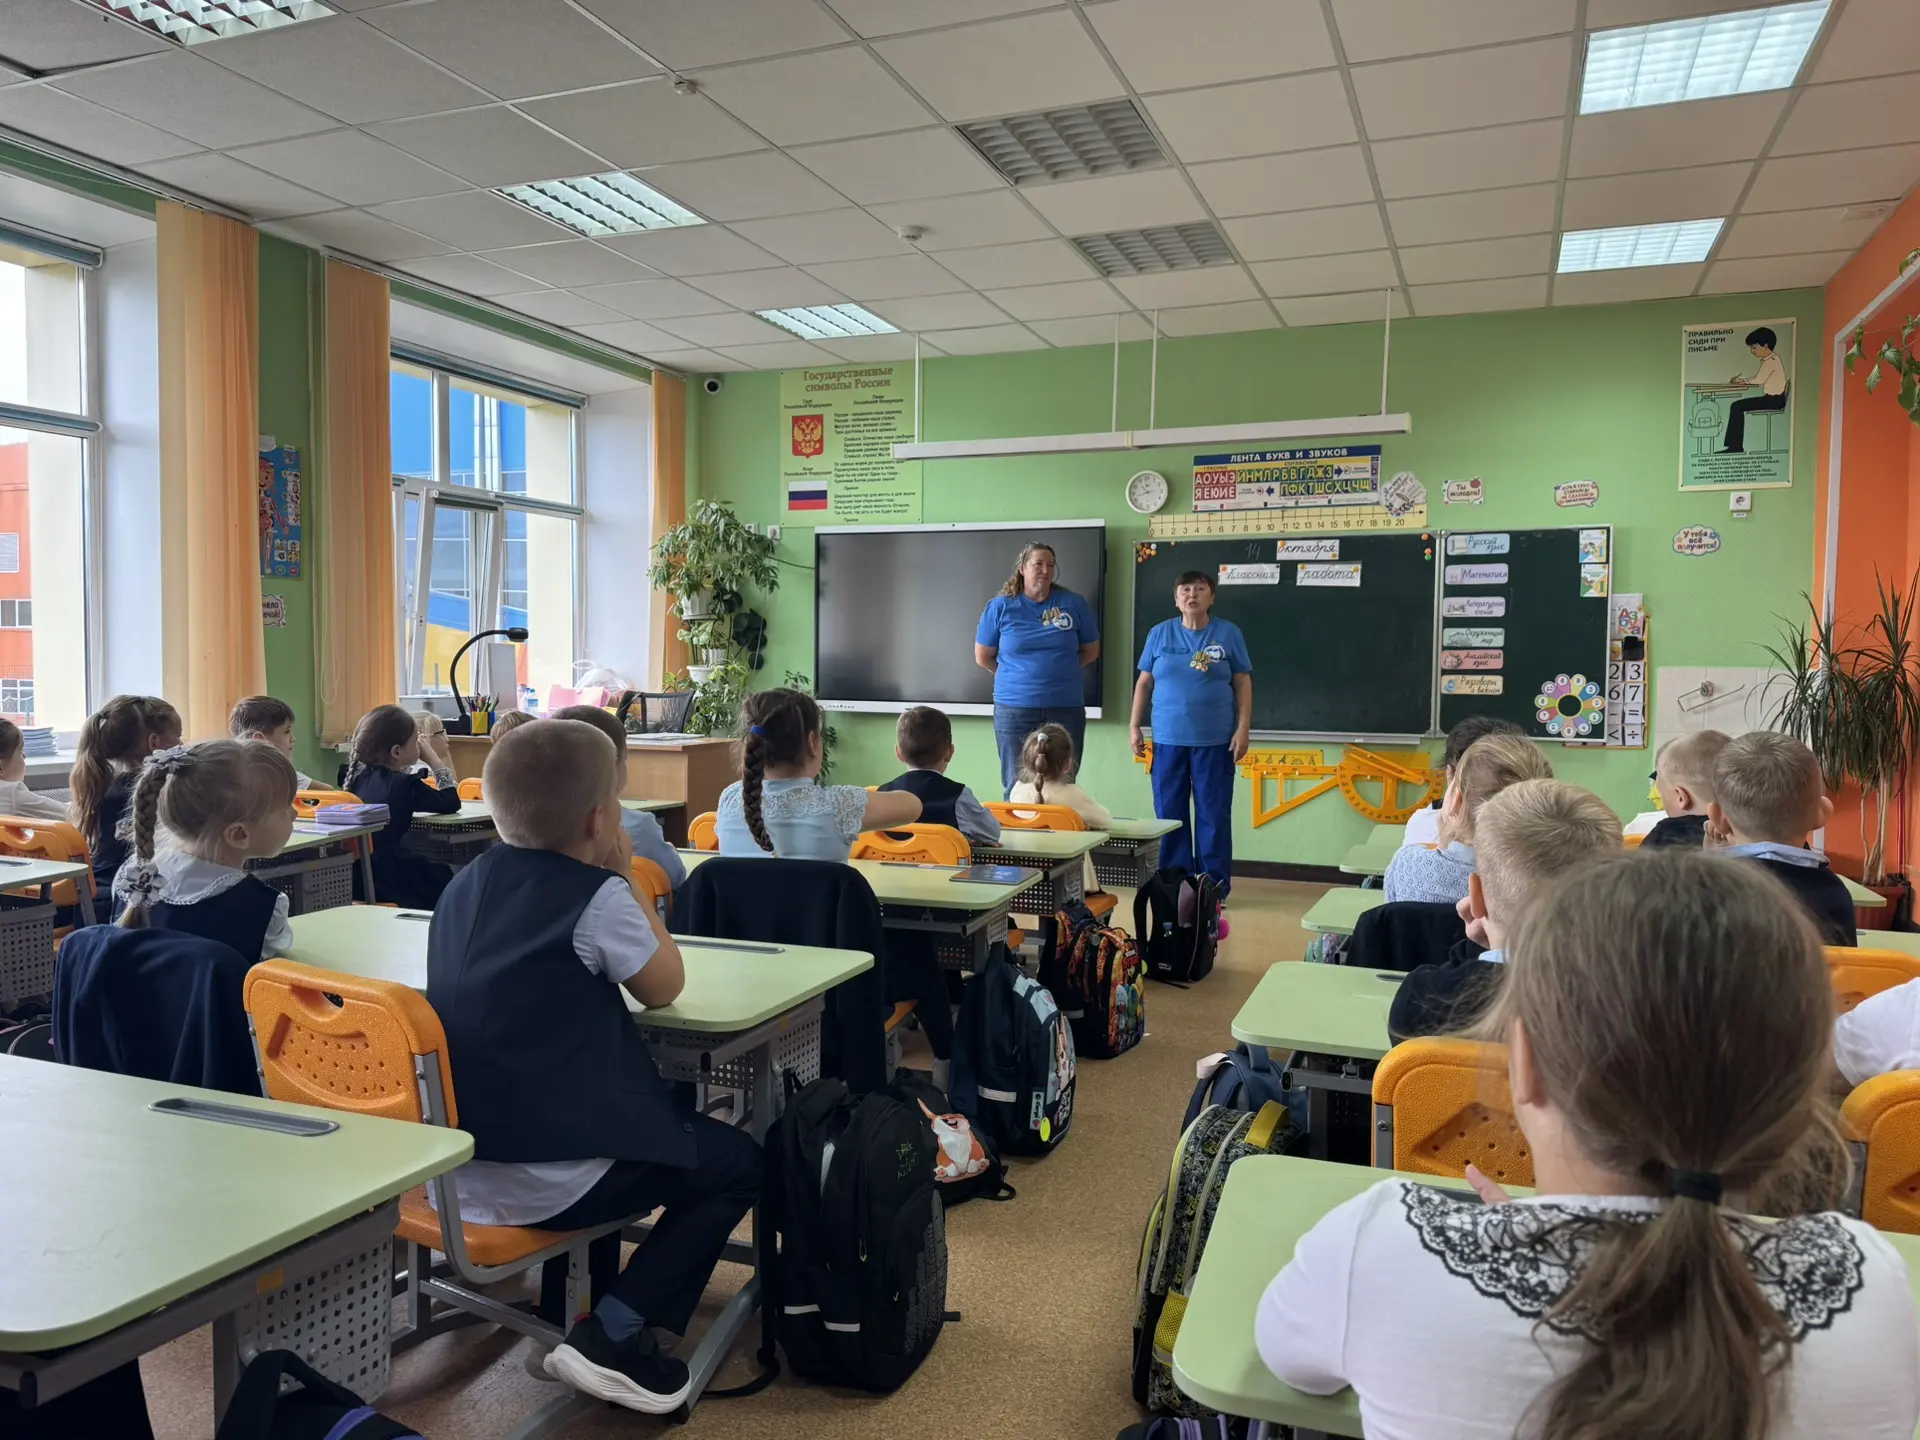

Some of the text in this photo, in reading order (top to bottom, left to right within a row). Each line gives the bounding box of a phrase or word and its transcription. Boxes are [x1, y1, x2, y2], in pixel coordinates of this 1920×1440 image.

[1688, 328, 1734, 338] ПРАВИЛЬНО
[1688, 338, 1708, 346] СИДИ
[1688, 345, 1719, 353] ПИСЬМЕ
[803, 368, 893, 382] Государственные
[805, 379, 891, 392] символы России
[1230, 454, 1260, 462] ЛЕНТА
[1266, 452, 1290, 460] БУКВ
[1308, 448, 1348, 458] ЗВУКОВ
[1150, 528, 1155, 536] 0
[1170, 527, 1176, 535] 2
[1194, 526, 1200, 534] 4
[1218, 525, 1224, 533] 6
[1255, 524, 1261, 532] 9
[1267, 523, 1275, 531] 10
[1305, 521, 1312, 529] 13
[1343, 520, 1351, 528] 16
[1370, 519, 1378, 527] 18
[1382, 519, 1391, 527] 19
[1395, 518, 1405, 526] 20
[1468, 536, 1497, 548] Русский
[1462, 568, 1507, 578] Математика
[1481, 638, 1493, 646] мир
[1609, 664, 1640, 680] 2 3
[1460, 676, 1496, 688] Разговоры
[1609, 684, 1620, 700] 6
[1629, 685, 1640, 701] 7
